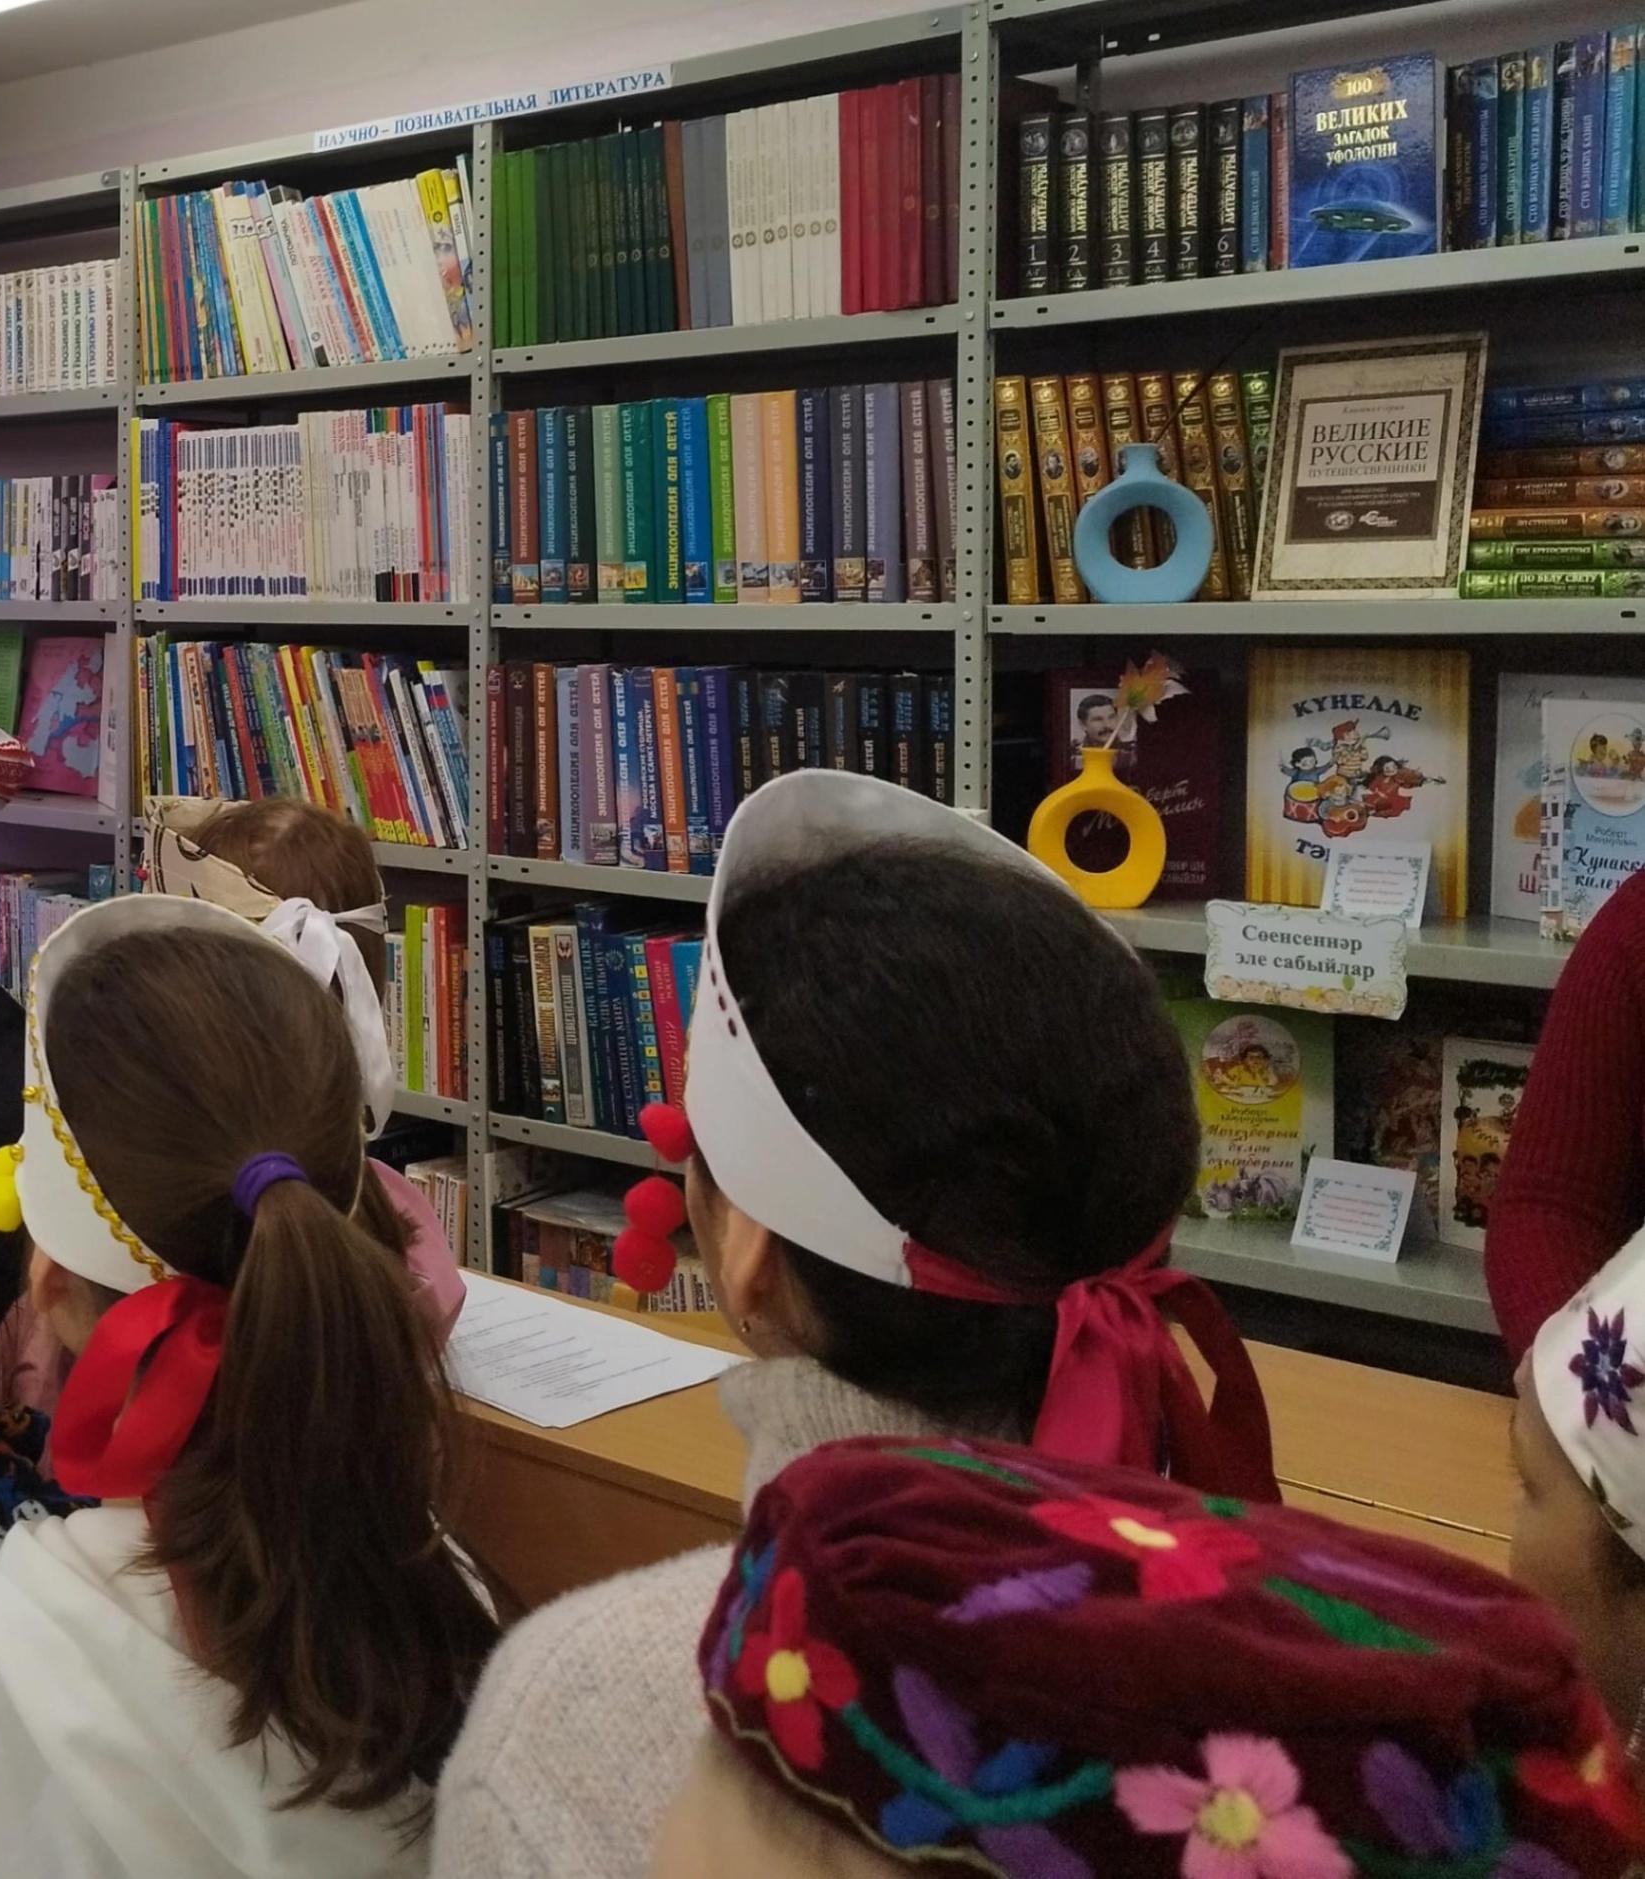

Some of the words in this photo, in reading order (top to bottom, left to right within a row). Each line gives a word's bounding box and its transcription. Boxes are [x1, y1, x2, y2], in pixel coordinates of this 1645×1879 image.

[1345, 78, 1373, 97] 100
[318, 125, 379, 148] НАУЧНО
[394, 94, 538, 134] ПОЗНАВАТЕЛЬНАЯ
[548, 71, 666, 106] ЛИТЕРАТУРА
[1315, 99, 1408, 132] ВЕЛИКИХ
[1334, 125, 1390, 147] ЗАГАДОК
[1326, 142, 1397, 168] УФОЛОГИИ
[1038, 163, 1047, 232] ЛИТЕРАТУРЫ
[1076, 163, 1087, 231] ЛИТЕРАТУРЫ
[1117, 162, 1129, 230] ЛИТЕРАТУРЫ
[1154, 161, 1165, 229] ЛИТЕРАТУРЫ
[1186, 157, 1198, 227] ЛИТЕРАТУРЫ
[1224, 154, 1236, 224] ЛИТЕРАТУРЫ
[1581, 191, 1590, 209] СТО
[1609, 190, 1619, 207] СТО
[1480, 210, 1488, 225] СТО
[1507, 205, 1515, 220] СТО
[1529, 205, 1538, 222] СТО
[1028, 245, 1037, 262] 1
[1069, 245, 1080, 262] 2
[1112, 243, 1122, 261] 3
[1147, 241, 1159, 257] 4
[1181, 236, 1191, 254] 5
[1218, 234, 1229, 252] 6
[803, 397, 813, 432] ДЕТЕЙ
[842, 393, 851, 428] ДЕТЕЙ
[911, 390, 922, 426] ДЕТЕЙ
[517, 417, 526, 448] ДЕТЕЙ
[545, 413, 554, 444] ДЕТЕЙ
[567, 415, 576, 446] ДЕТЕЙ
[622, 409, 632, 442] ДЕТЕЙ
[665, 411, 677, 450] ДЕТЕЙ
[1312, 418, 1432, 444] ВЕЛИКИЕ
[624, 446, 633, 466] ДЛЯ
[804, 437, 813, 459] ДЛЯ
[842, 433, 851, 455] ДЛЯ
[913, 430, 923, 453] ДЛЯ
[1309, 441, 1429, 467] РУССКИЕ
[518, 453, 527, 472] ДЛЯ
[545, 448, 554, 467] ДЛЯ
[568, 450, 577, 471] ДЛЯ
[667, 456, 678, 481] ДЛЯ
[1308, 463, 1427, 478] ПУТЕШЕСТВЕННИКИ
[518, 476, 528, 558] ЭНЦИКЛОПЕДИЯ
[546, 473, 555, 554] ЭНЦИКЛОПЕДИЯ
[569, 475, 579, 557] ЭНЦИКЛОПЕДИЯ
[625, 471, 636, 555] ЭНЦИКЛОПЕДИЯ
[805, 463, 814, 553] ЭНЦИКЛОПЕДИЯ
[843, 460, 852, 550] ЭНЦИКЛОПЕДИЯ
[915, 458, 927, 551] ЭНЦИКЛОПЕДИЯ
[668, 486, 679, 589] ЭНЦИКЛОПЕДИЯ
[537, 671, 546, 702] ДЕТЕЙ
[569, 680, 579, 717] ДЕТЕЙ
[591, 672, 601, 704] ДЕТЕЙ
[614, 678, 626, 717] ДЕТЕЙ
[659, 677, 669, 709] ДЕТЕЙ
[538, 707, 546, 726] ДЛЯ
[593, 708, 603, 729] ДЛЯ
[661, 714, 671, 734] ДЛЯ
[570, 723, 579, 747] ДЛЯ
[618, 723, 627, 747] ДЛЯ
[643, 699, 656, 773] САНКТ-ПЕТЕРБУРГ
[537, 731, 547, 812] ЭНЦИКЛОПЕДИЯ
[595, 733, 607, 816] ЭНЦИКЛОПЕДИЯ
[665, 739, 677, 824] ЭНЦИКЛОПЕДИЯ
[570, 752, 580, 850] ЭНЦИКЛОПЕДИЯ
[647, 783, 658, 819] МОСКВА
[1295, 838, 1331, 863] ТӘ
[1574, 845, 1645, 875] Кунакк
[1242, 924, 1363, 955] Сөенсеннәр
[1273, 954, 1375, 981] сабыйлар
[561, 974, 577, 1045] ЦИВИЛИЗАЦИИ
[612, 997, 625, 1031] МИРА
[617, 1035, 633, 1099] СТОЛИЦЫ
[625, 1103, 636, 1126] ВСЕ
